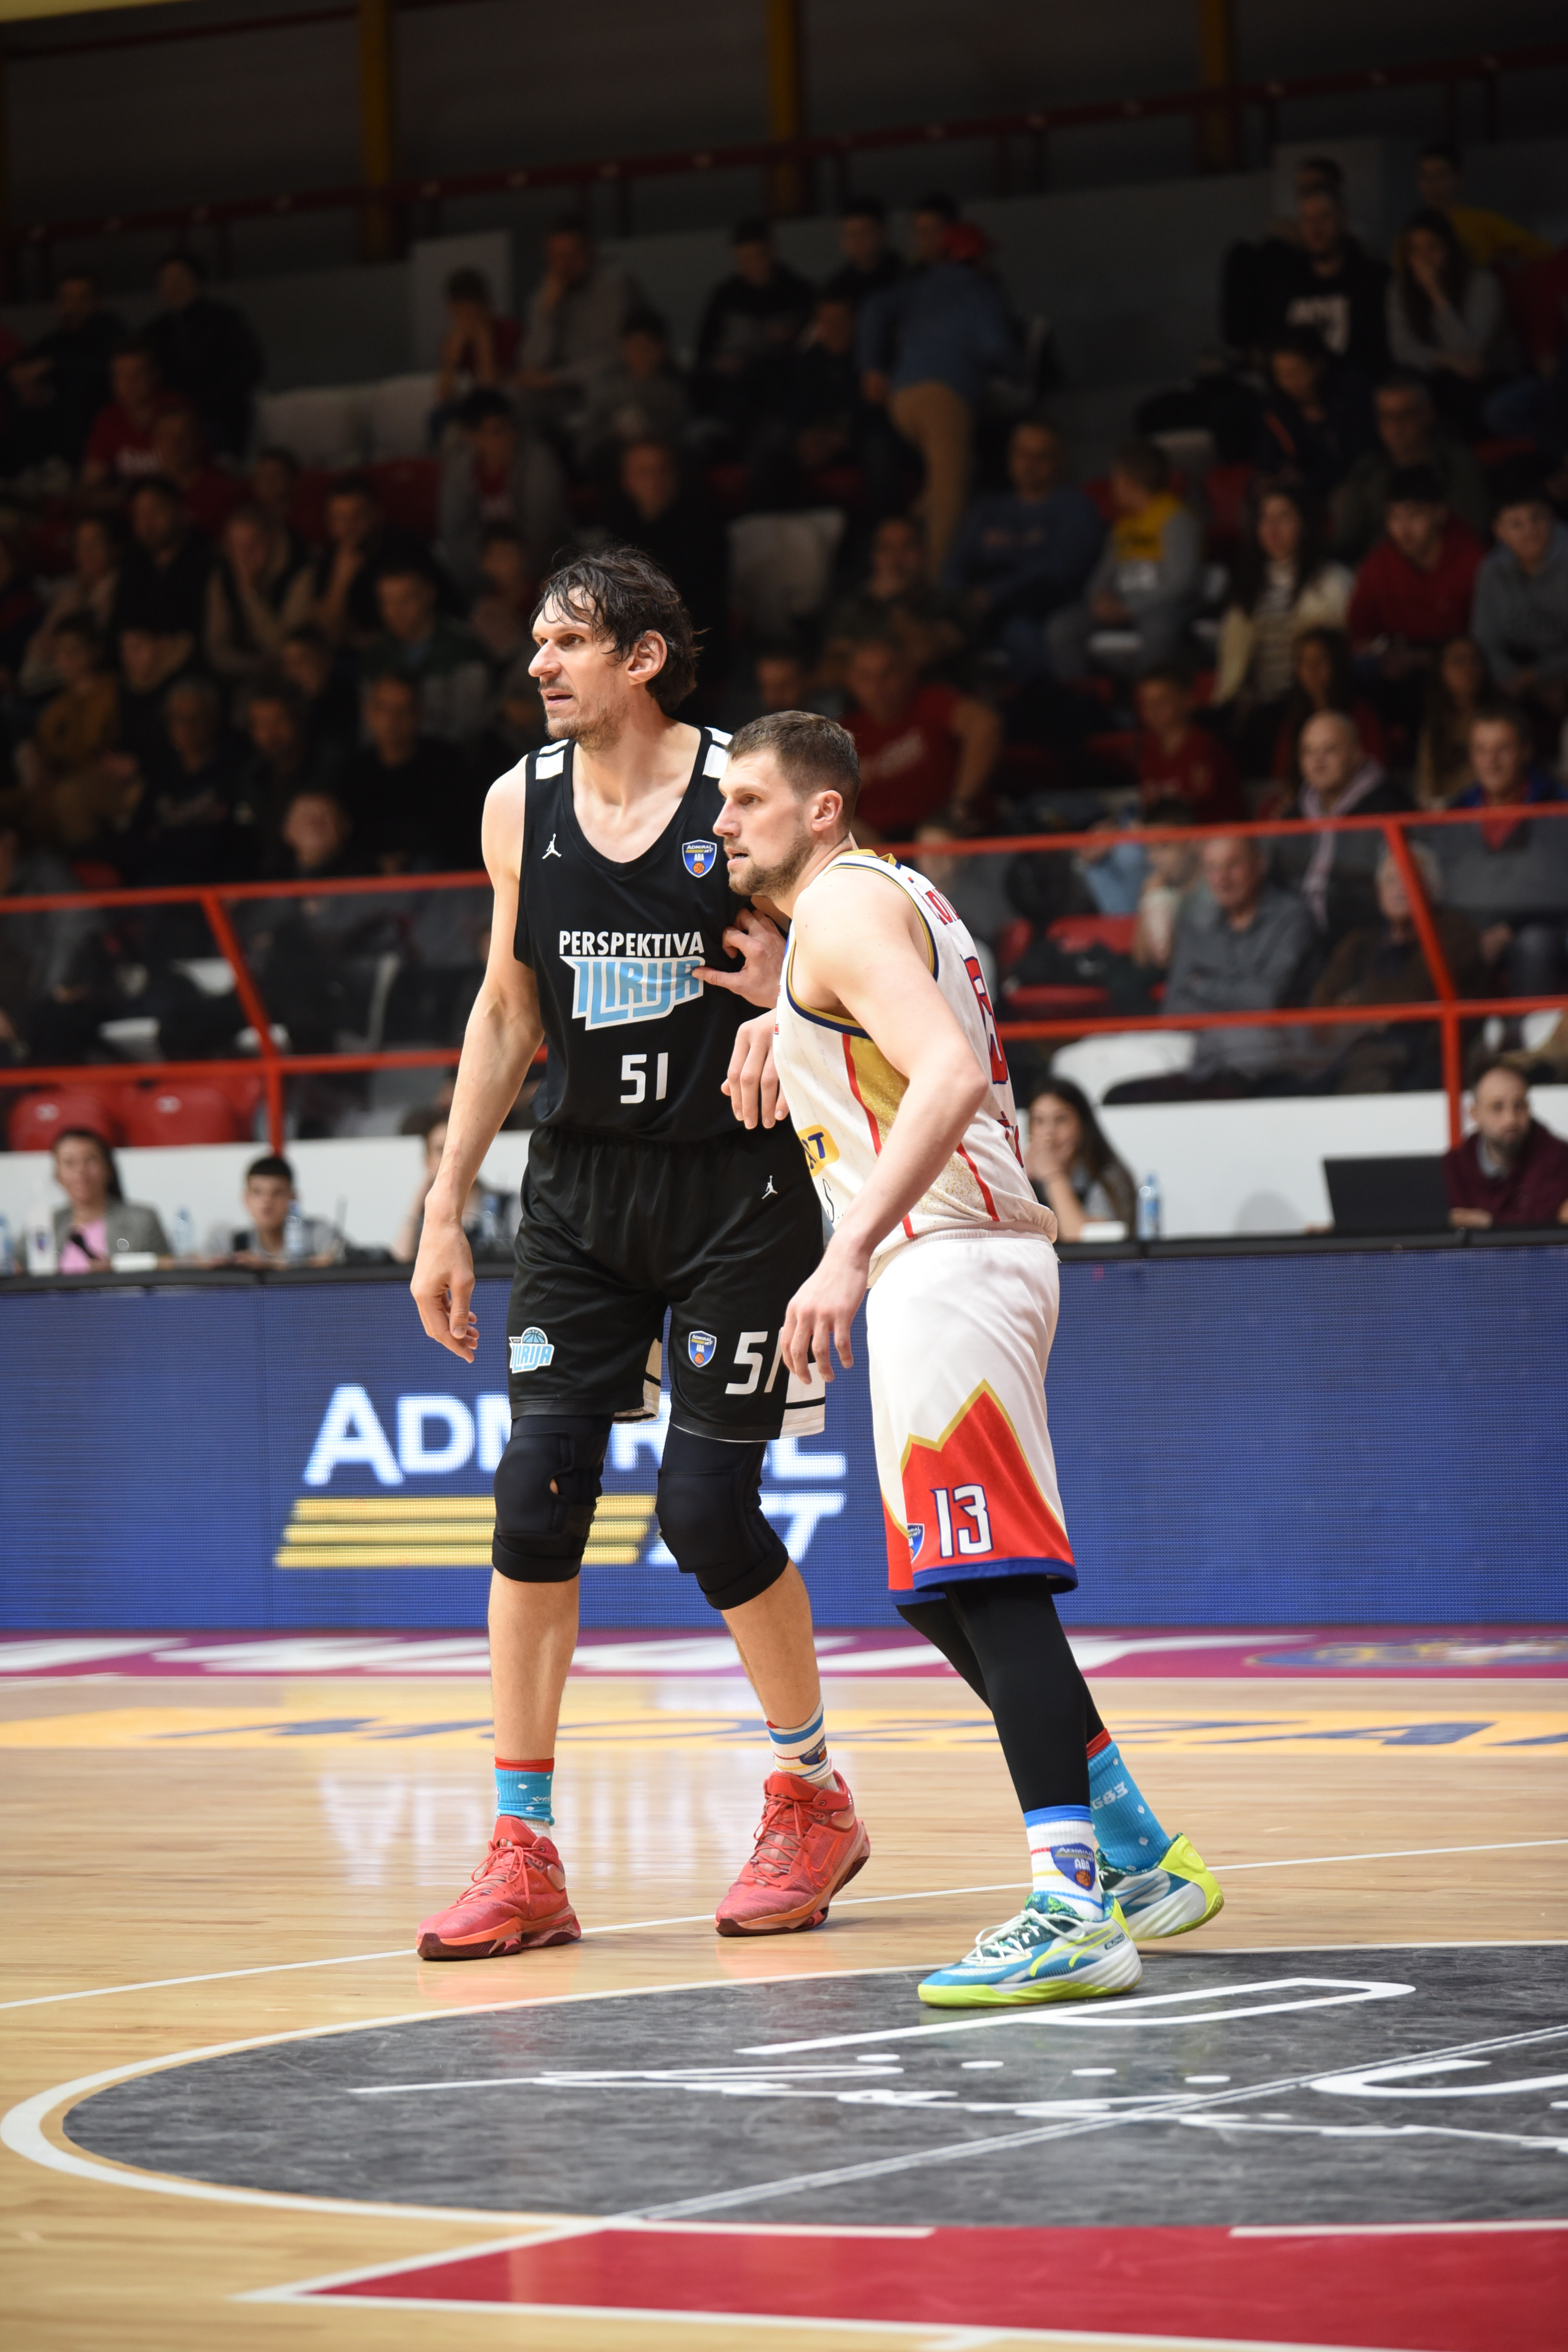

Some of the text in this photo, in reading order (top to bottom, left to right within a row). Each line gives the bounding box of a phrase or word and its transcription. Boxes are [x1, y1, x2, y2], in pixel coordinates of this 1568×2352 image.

[559, 930, 704, 957] PERSPEKTIVA
[620, 1052, 669, 1104] 51
[930, 1484, 994, 1559] 13
[1074, 1858, 1091, 1871] ABA
